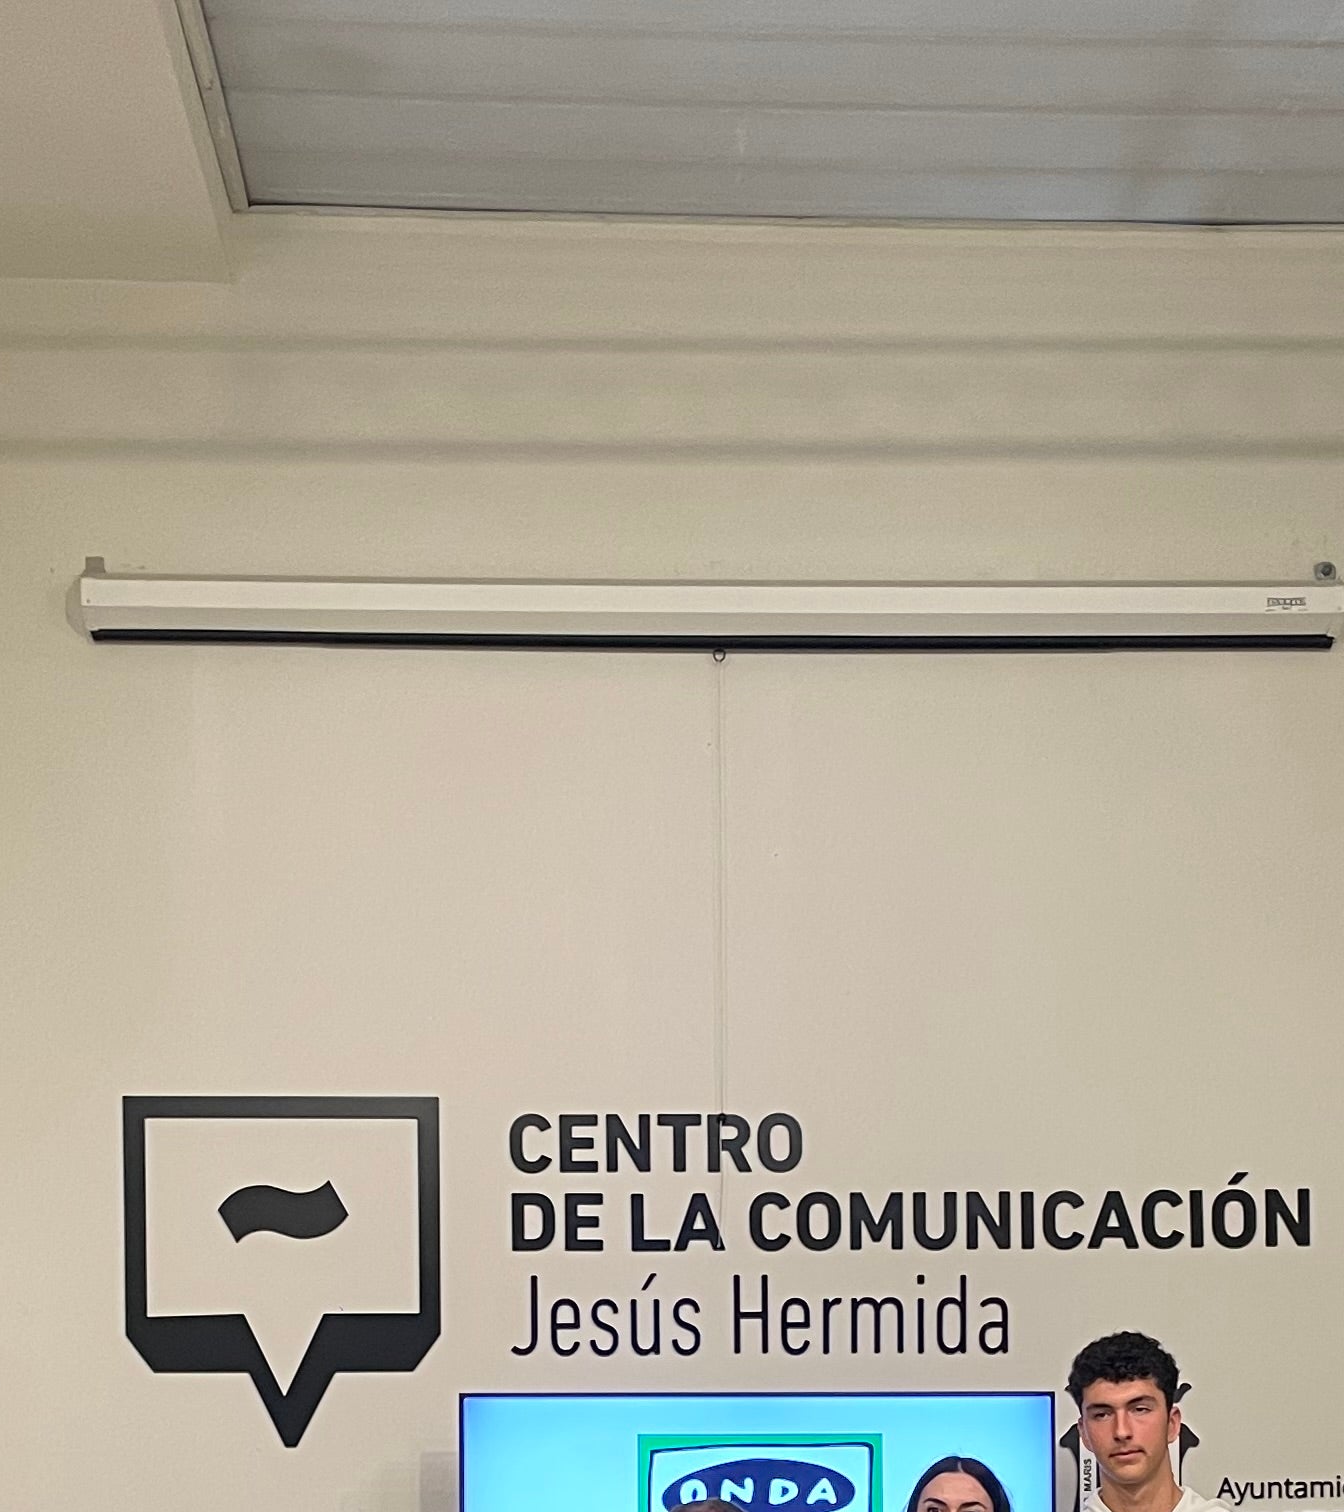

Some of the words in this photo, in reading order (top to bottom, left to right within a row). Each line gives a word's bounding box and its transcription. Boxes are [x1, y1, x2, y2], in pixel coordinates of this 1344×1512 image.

[509, 1112, 803, 1174] CENTRO
[511, 1192, 604, 1252] DE
[630, 1192, 726, 1252] LA
[749, 1171, 1312, 1252] COMUNICACIÓN
[510, 1272, 702, 1357] Jesús
[733, 1274, 1009, 1356] Hermida
[679, 1477, 837, 1505] ONDA
